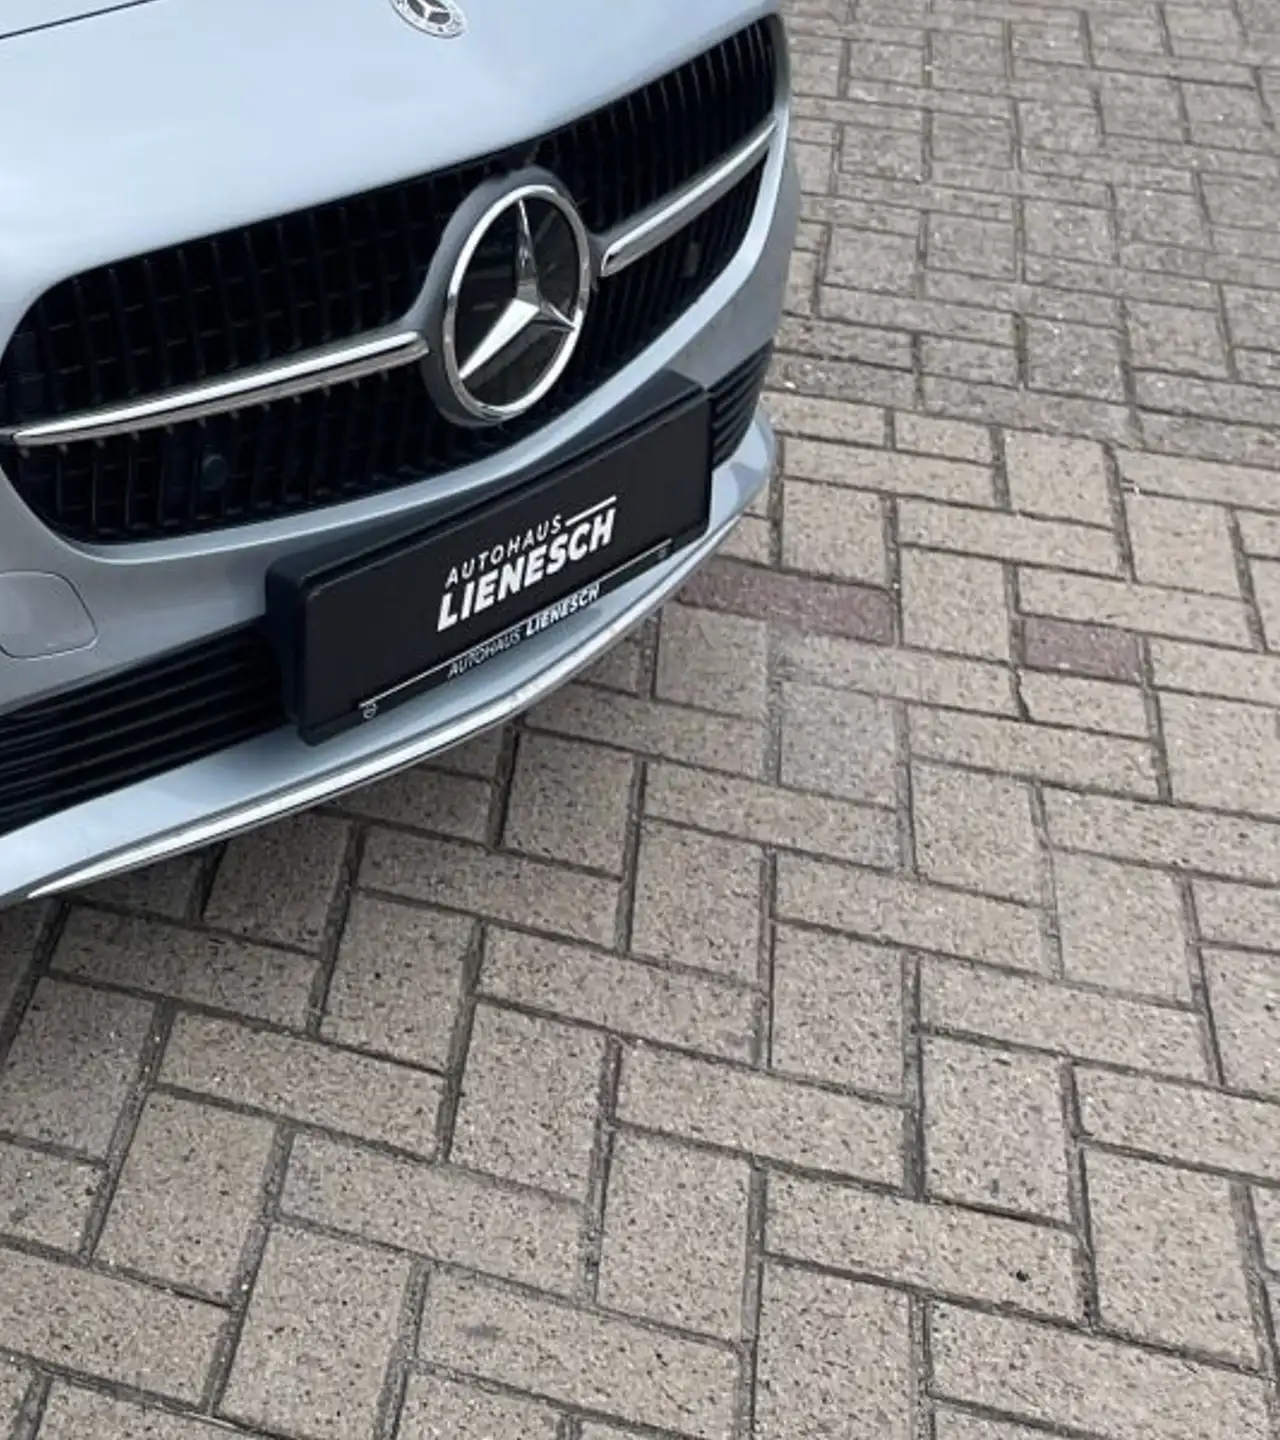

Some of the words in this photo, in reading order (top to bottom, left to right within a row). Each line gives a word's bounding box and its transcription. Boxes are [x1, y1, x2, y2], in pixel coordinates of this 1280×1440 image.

[437, 508, 616, 632] LIENESCH
[444, 513, 563, 589] AUTOHAUS
[447, 627, 521, 679] AUTOHAUS
[525, 583, 600, 637] LIENESCH
